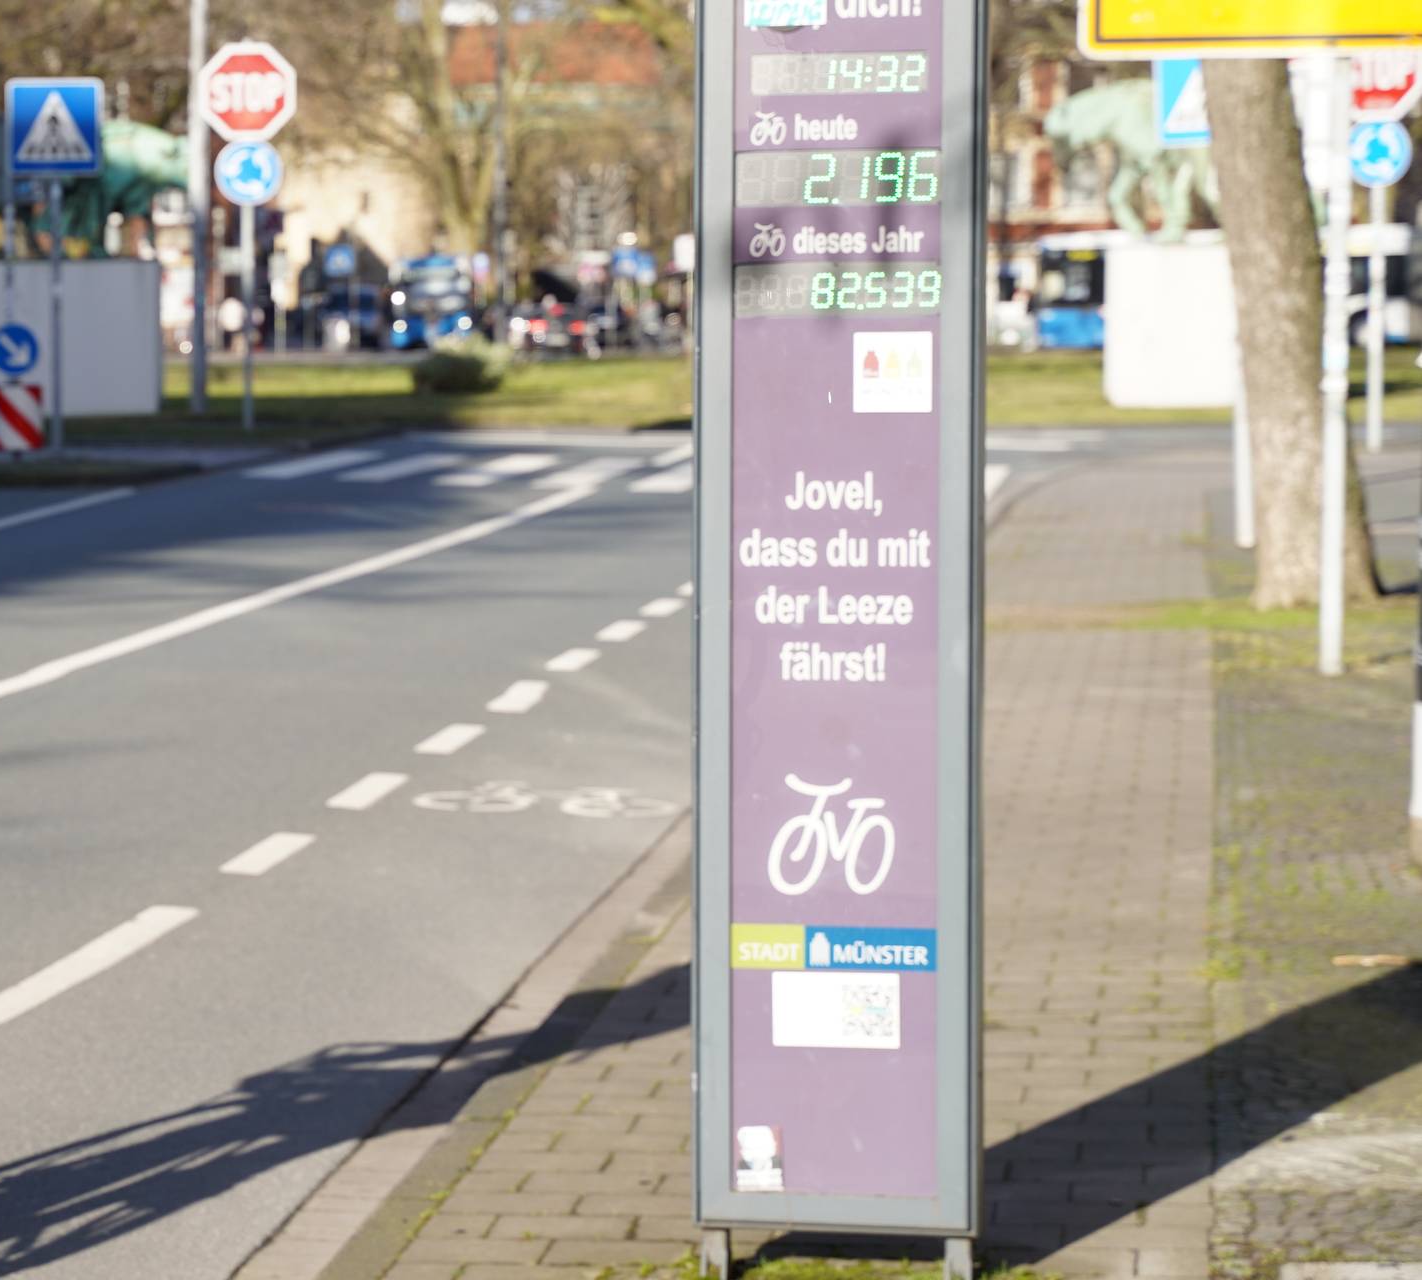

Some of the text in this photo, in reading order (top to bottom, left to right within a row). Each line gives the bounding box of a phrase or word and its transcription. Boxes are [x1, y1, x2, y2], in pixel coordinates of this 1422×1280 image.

[209, 71, 284, 112] STOP
[827, 55, 926, 92] 14:32
[794, 113, 858, 141] heute
[793, 225, 925, 254] dieses Jahr
[785, 471, 883, 516] Jovel,
[739, 528, 931, 567] dass du mit
[755, 585, 914, 625] der Leeze
[780, 642, 887, 682] fährst!
[738, 940, 929, 966] STADT MÜNSTER
